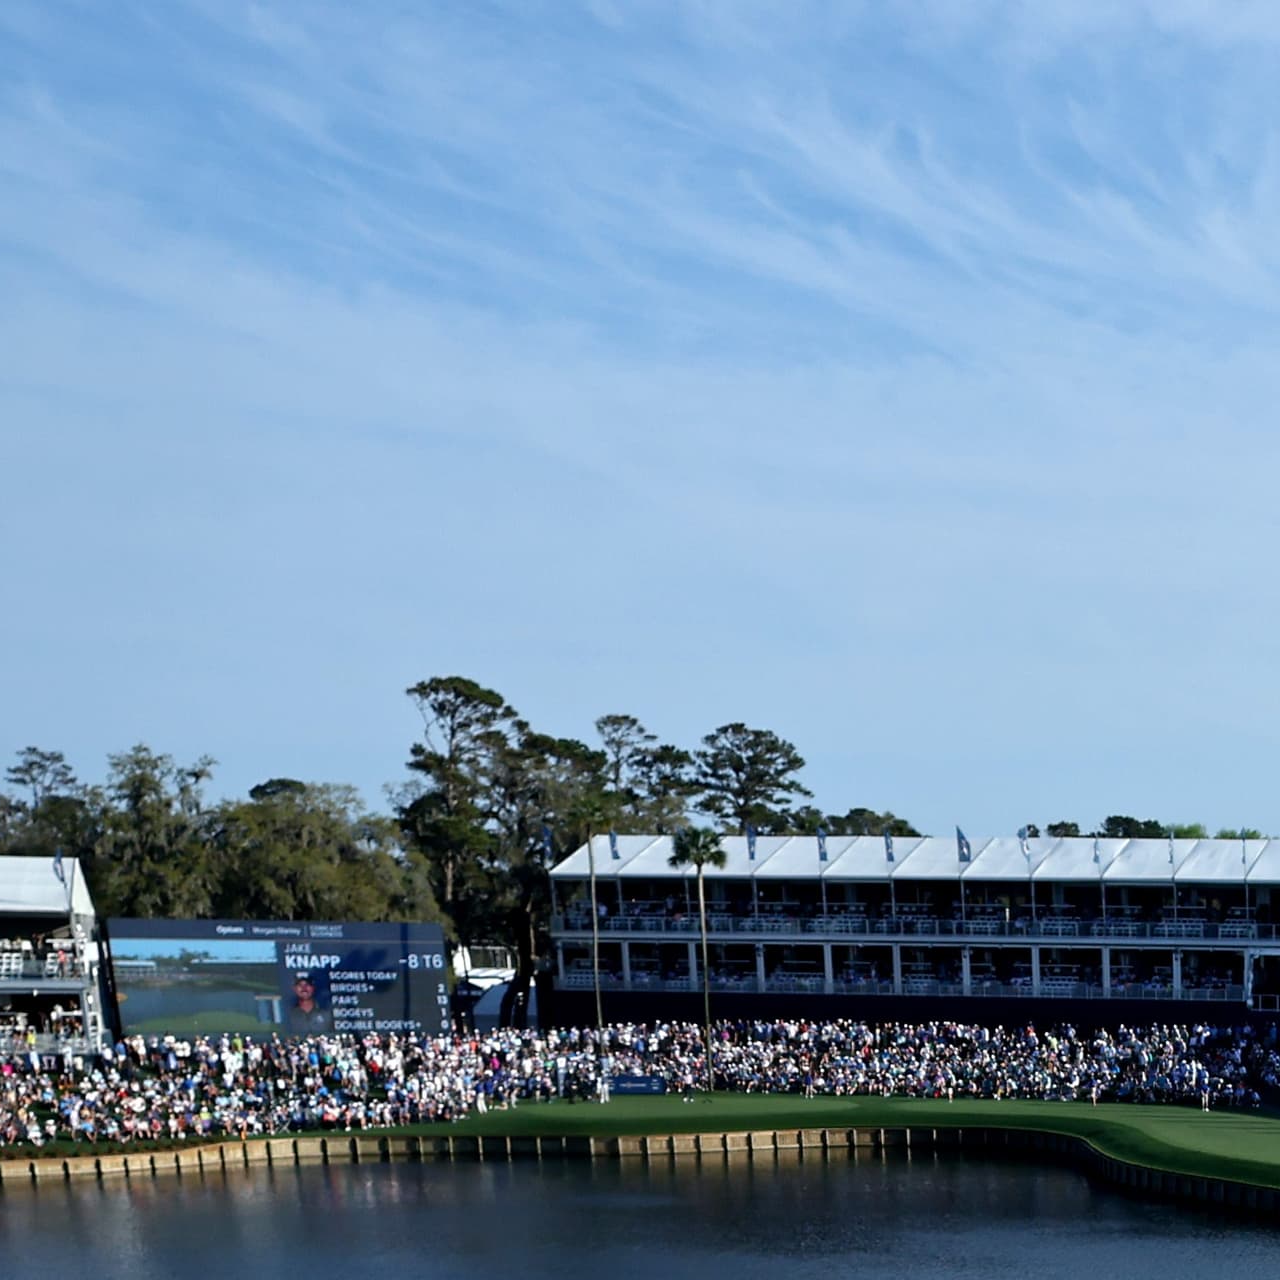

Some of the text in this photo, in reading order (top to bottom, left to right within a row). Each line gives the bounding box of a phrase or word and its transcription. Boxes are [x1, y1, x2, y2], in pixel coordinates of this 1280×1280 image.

[284, 943, 311, 954] JAKE
[284, 954, 341, 969] KNAPP
[399, 953, 443, 969] -8 T6
[329, 971, 398, 980] SCORES TODAY
[331, 995, 359, 1005] PARS
[333, 1008, 375, 1018] BOGEYS
[334, 1020, 373, 1030] DOUBLE
[440, 1019, 449, 1029] 0
